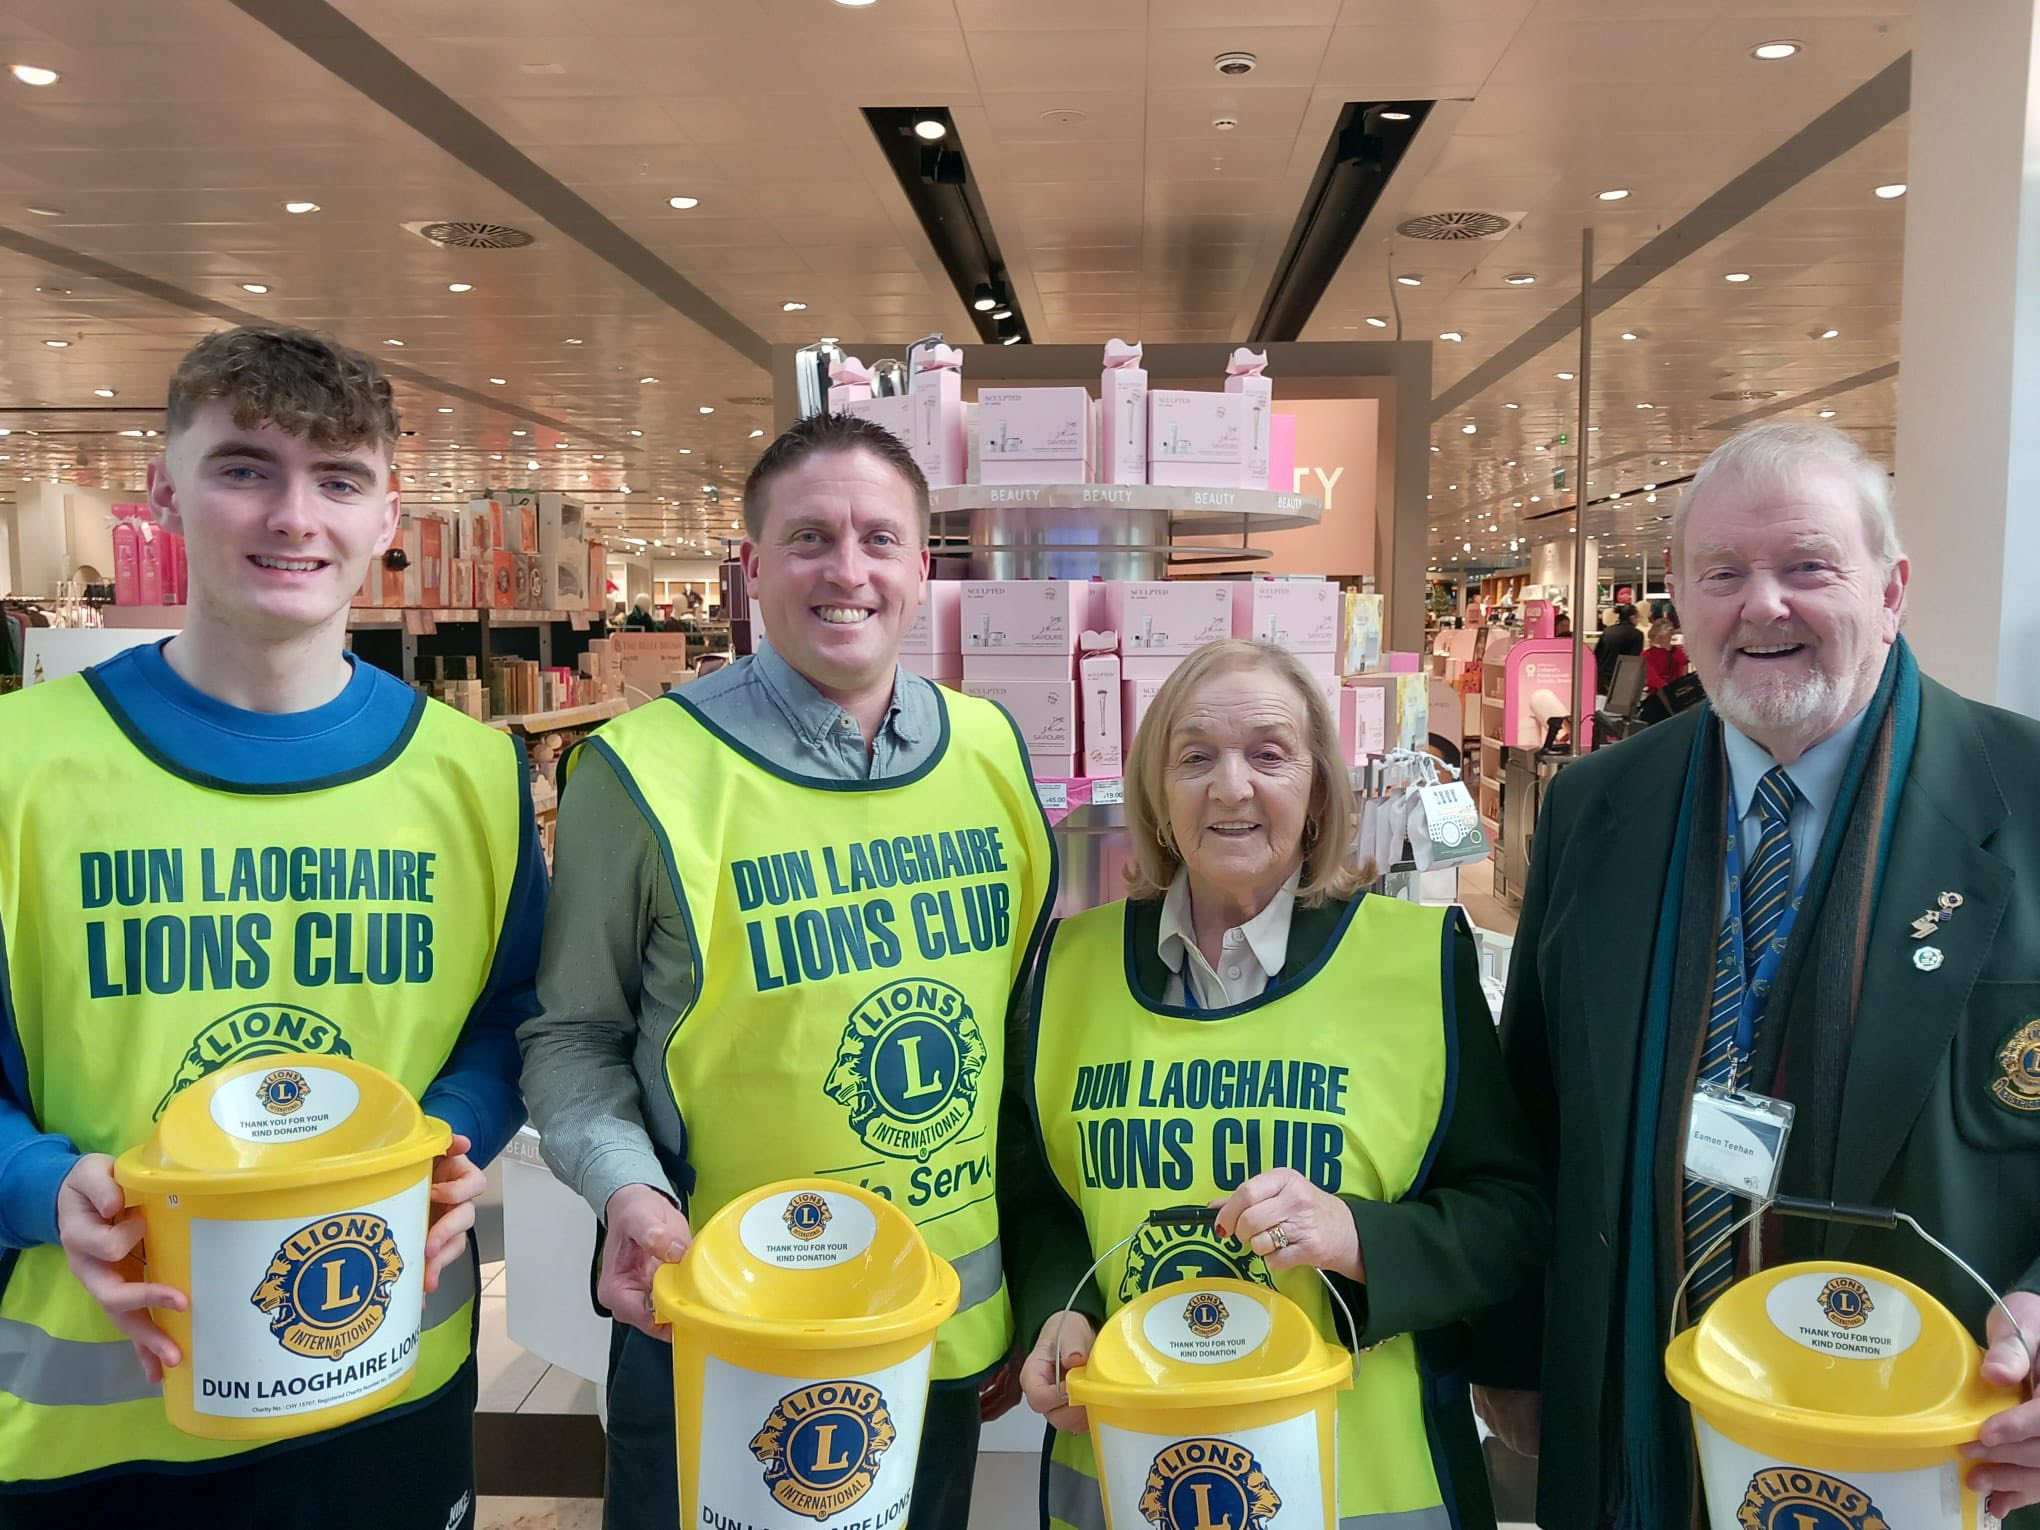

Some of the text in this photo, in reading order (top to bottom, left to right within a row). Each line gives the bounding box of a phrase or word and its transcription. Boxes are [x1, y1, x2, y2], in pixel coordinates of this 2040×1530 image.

[990, 489, 1040, 502] BEAUTY
[1082, 489, 1133, 503] BEAUTY
[1194, 492, 1235, 505] BEAUTY
[1277, 496, 1302, 509] BEAUTY
[80, 846, 436, 909] DUN LAOGHAIRE
[731, 826, 1008, 911] DUN LAOGHAIRE
[746, 882, 1010, 992] LIONS CLUB
[86, 911, 434, 999] LIONS CLUB
[859, 984, 957, 1032] LIONS
[206, 1012, 329, 1057] LIONS
[268, 1071, 299, 1083] LIONS
[897, 1035, 943, 1100] L
[278, 1084, 292, 1101] L
[1070, 1059, 1350, 1116] DUN LAOGHAIRE
[240, 1113, 329, 1129] THANK YOU FOR YOUR
[252, 1125, 318, 1138] KIND DONATION
[872, 1106, 965, 1149] INTERNATIONAL
[1077, 1117, 1194, 1191] LIONS
[1694, 1130, 1754, 1156] Eamon Teehan
[168, 1194, 179, 1205] 10
[794, 1193, 821, 1205] LIONS
[801, 1207, 815, 1225] L
[290, 1218, 382, 1257] LIONS
[766, 1245, 793, 1253] THANK
[793, 1244, 810, 1252] YOU
[826, 1243, 848, 1251] YOUR
[796, 1253, 837, 1262] DONATION
[321, 1259, 360, 1311] L
[1830, 1279, 1863, 1292] LIONS
[1192, 1294, 1219, 1305] LIONS
[1839, 1293, 1854, 1312] L
[1200, 1307, 1213, 1323] L
[290, 1312, 379, 1350] INTERNATIONAL
[1799, 1326, 1892, 1346] THANK YOU FOR YOUR
[1170, 1341, 1194, 1349] THANK
[1180, 1349, 1237, 1358] KIND DONATION
[1812, 1339, 1881, 1356] KIND DONATION
[202, 1326, 420, 1399] DUN LAOGHAIRE LIONS
[346, 1387, 363, 1398] Charity
[788, 1386, 874, 1415] LIONS
[811, 1424, 849, 1471] L
[1161, 1444, 1246, 1474] LIONS
[450, 1489, 468, 1522] NIKE
[780, 1480, 866, 1511] INTERNATIONAL
[1762, 1473, 1860, 1513] LIONS
[702, 1505, 742, 1530] DUN
[1190, 1483, 1232, 1530] L
